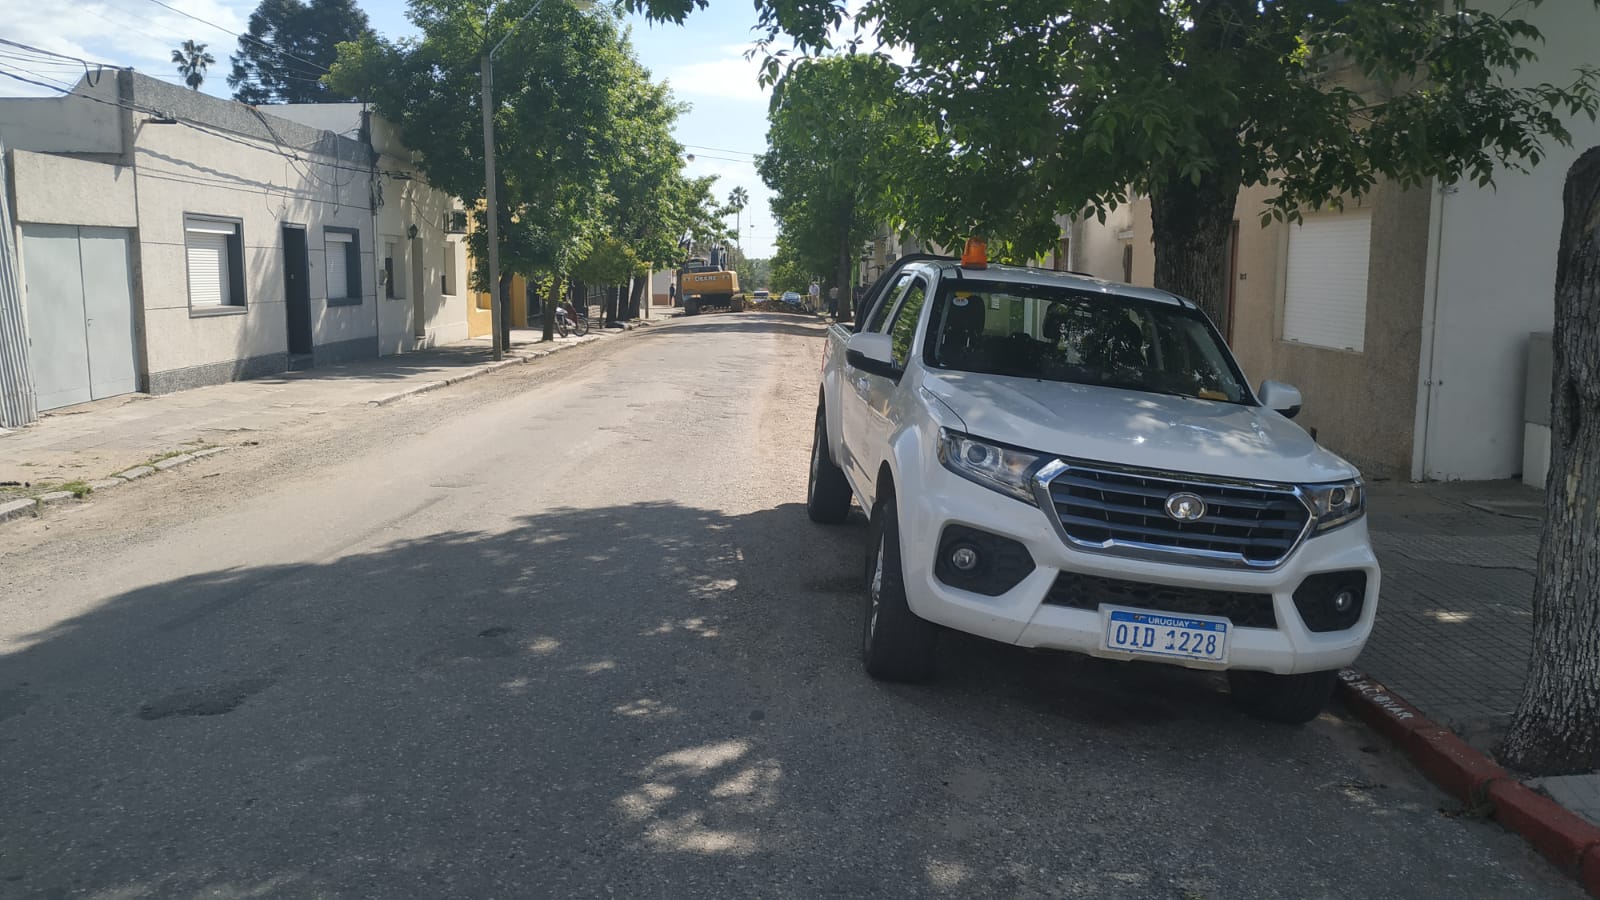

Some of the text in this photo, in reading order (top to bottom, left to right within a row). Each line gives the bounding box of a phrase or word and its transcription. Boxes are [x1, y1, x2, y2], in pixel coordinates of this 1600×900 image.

[1148, 617, 1190, 628] URUGUAY
[1115, 624, 1217, 655] OID 1228
